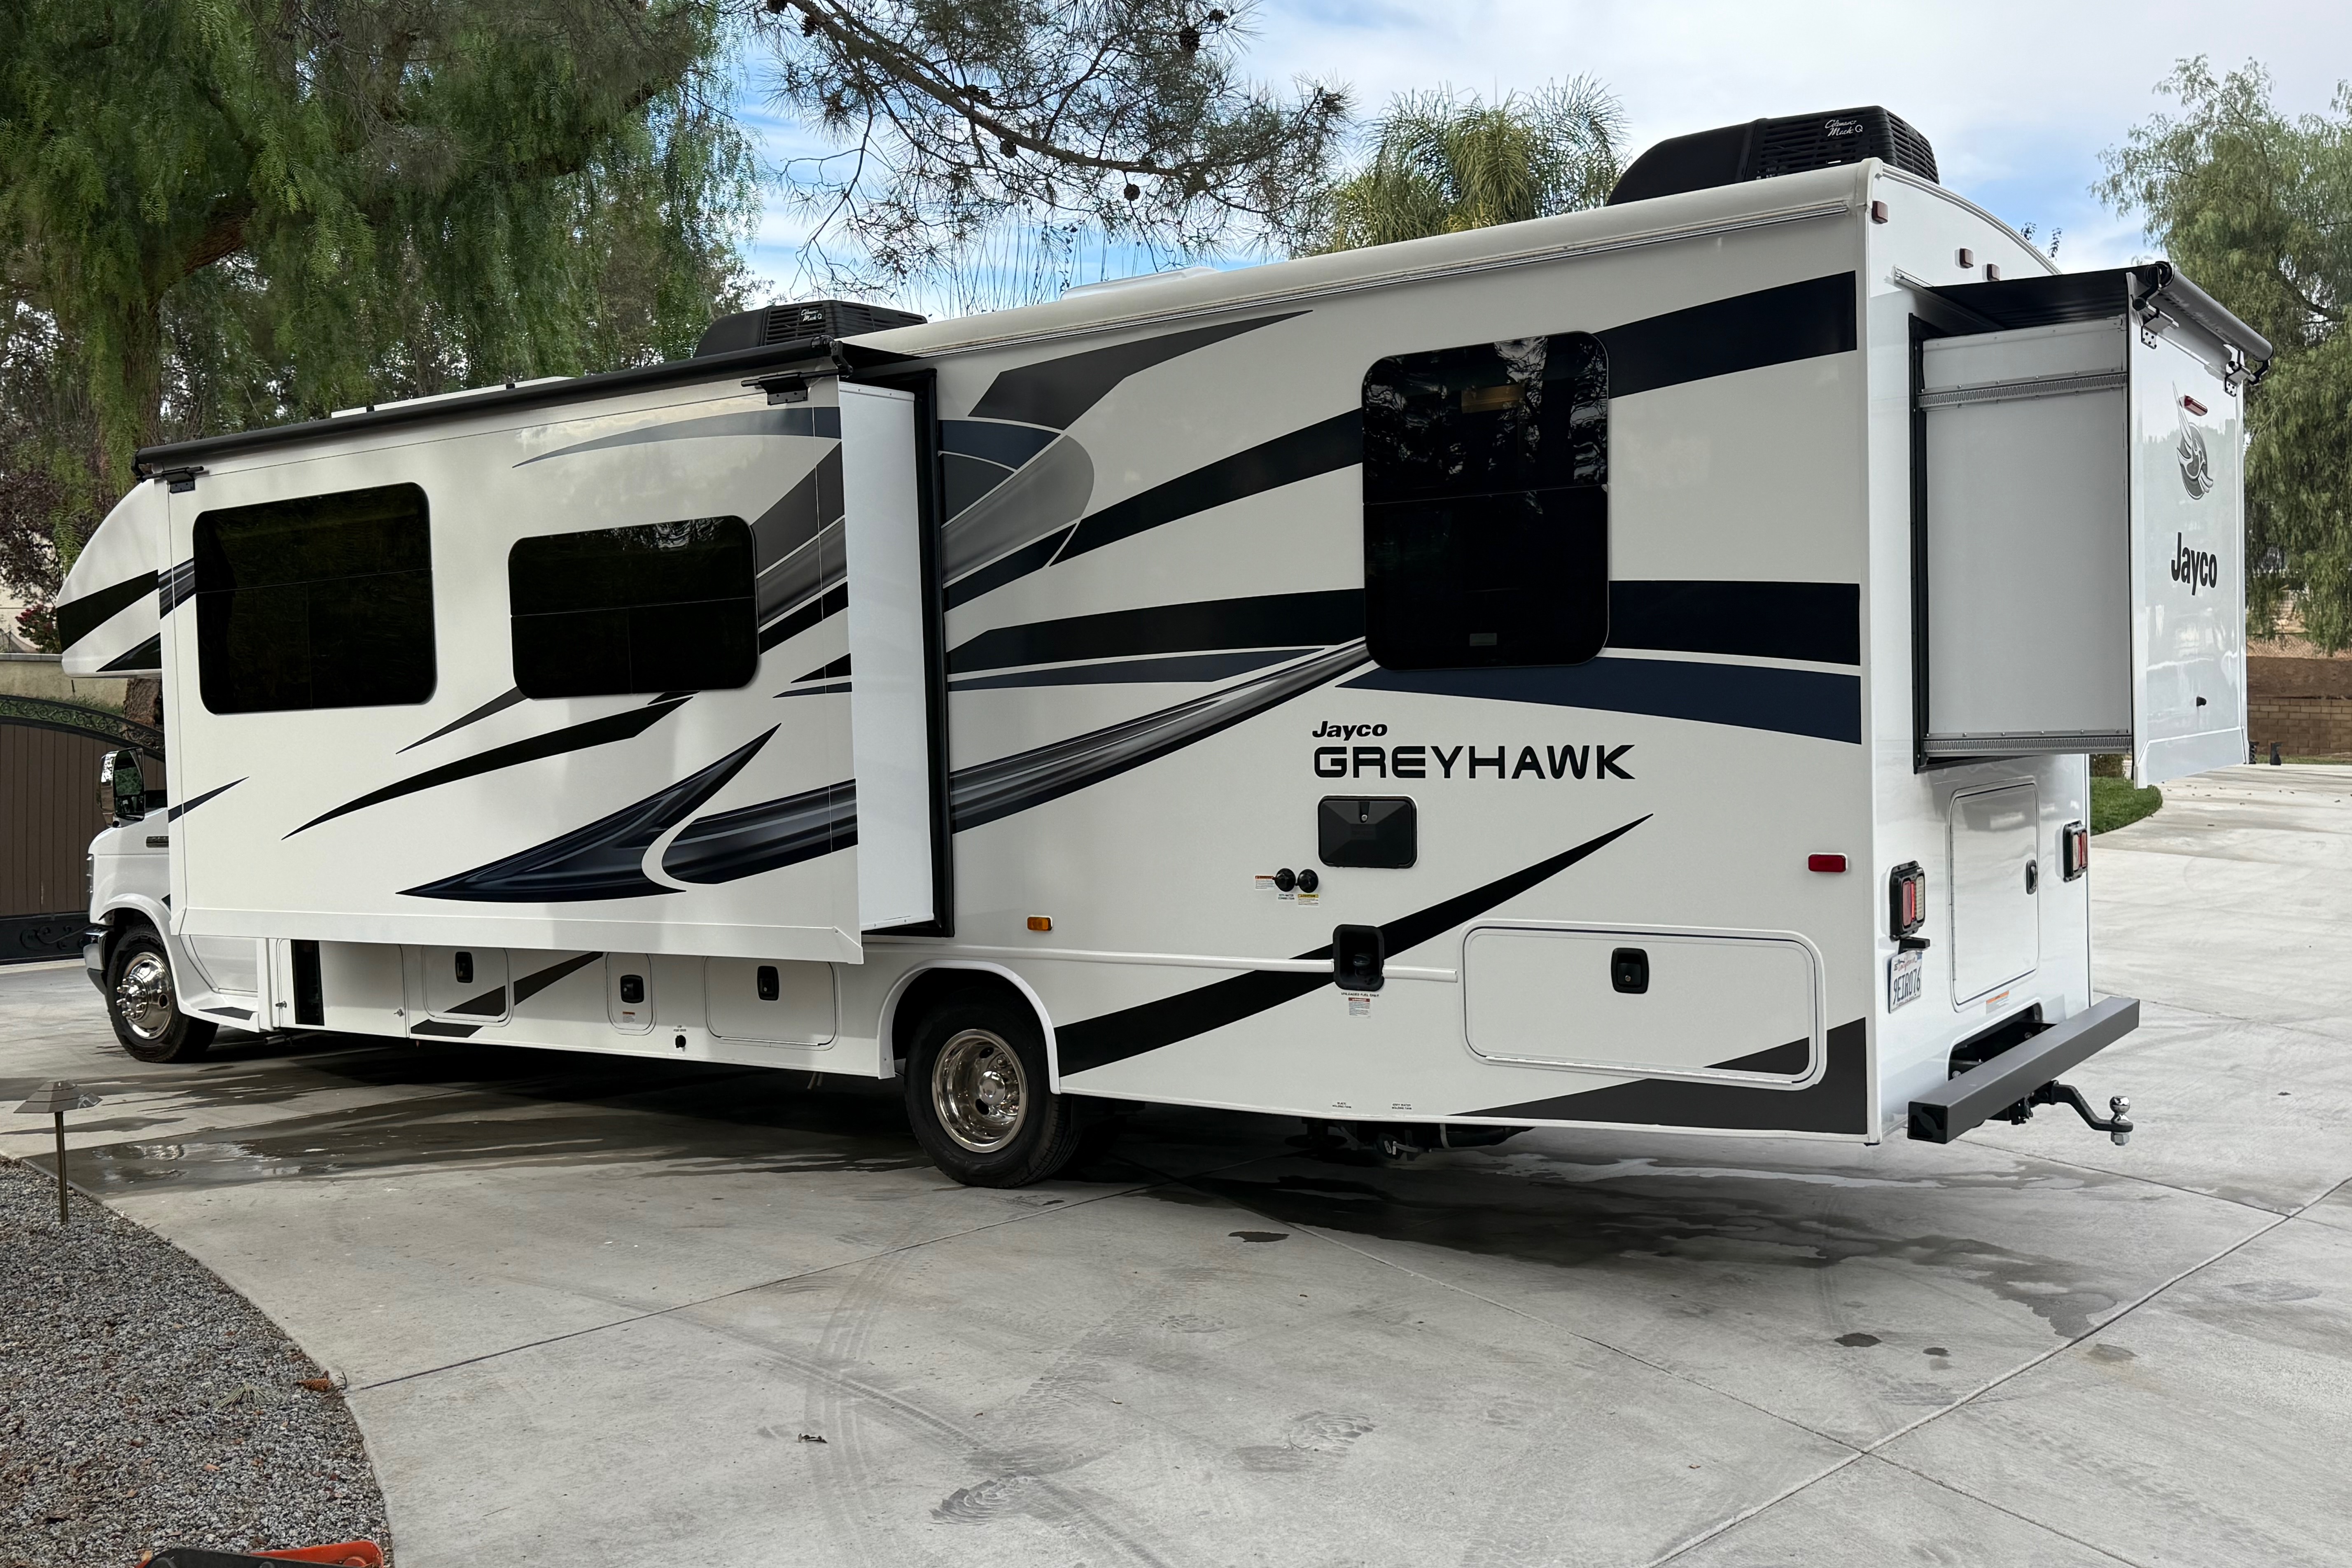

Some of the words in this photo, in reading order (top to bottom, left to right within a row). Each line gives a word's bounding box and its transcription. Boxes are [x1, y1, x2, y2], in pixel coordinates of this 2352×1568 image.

[1855, 124, 1863, 133] Q
[2171, 532, 2217, 596] Jayco
[1312, 721, 1388, 741] Jayco
[1314, 744, 1636, 779] GREYHAWK
[1893, 966, 1921, 1005] 9EIR076
